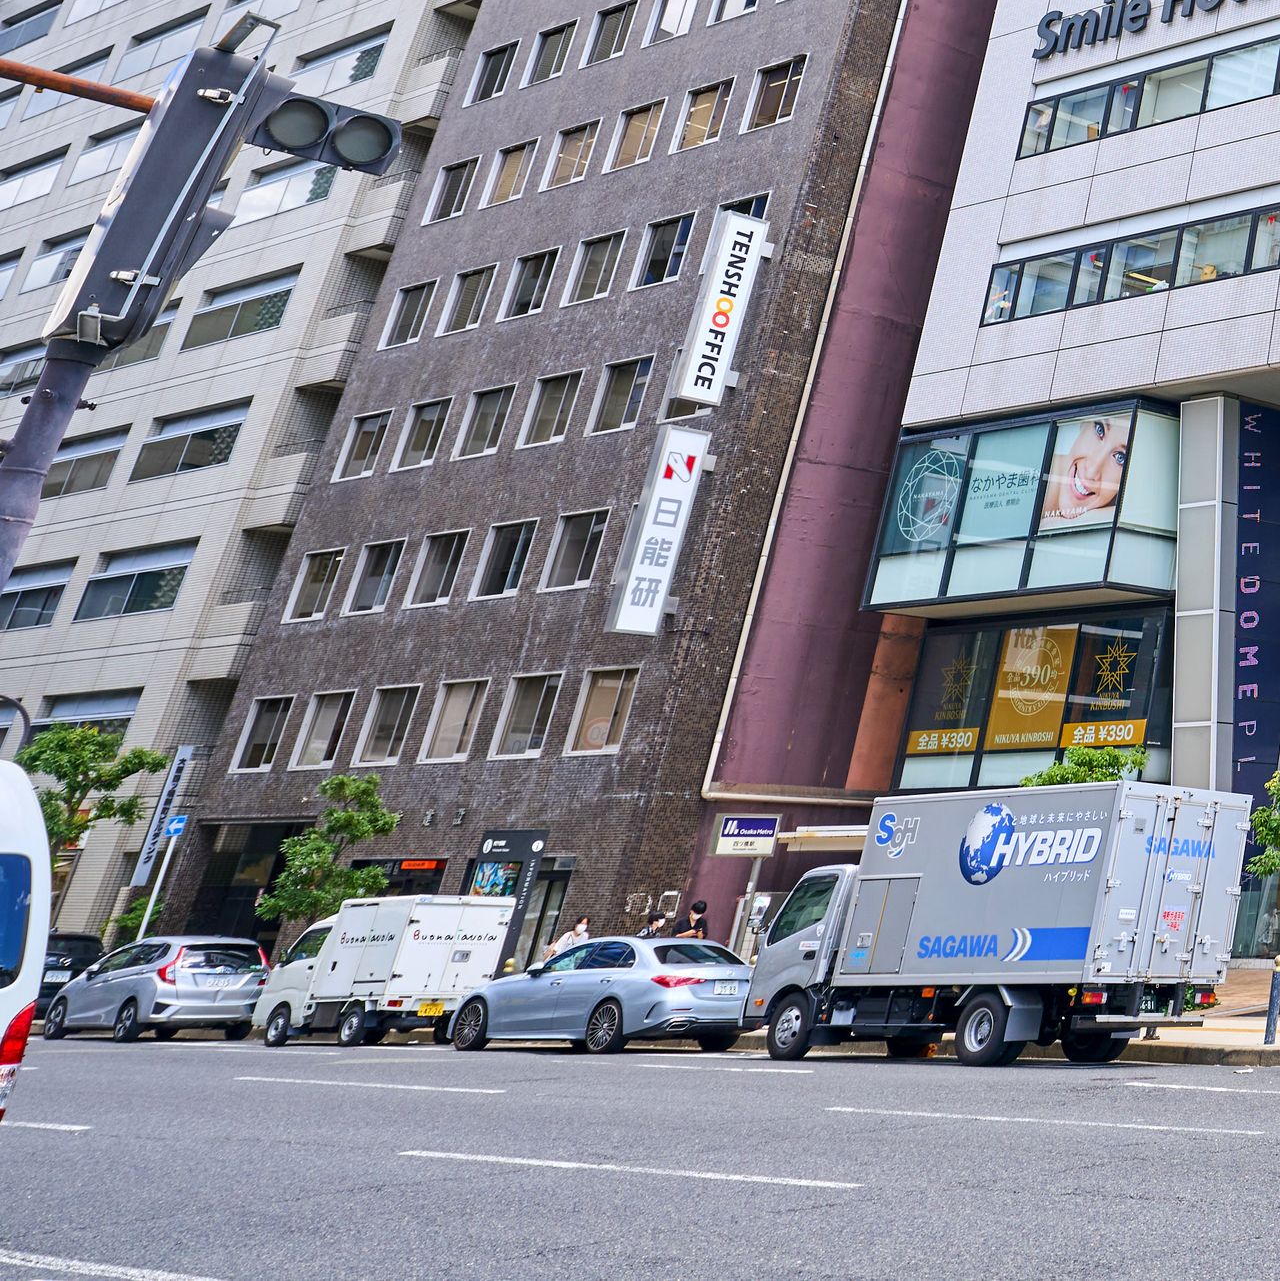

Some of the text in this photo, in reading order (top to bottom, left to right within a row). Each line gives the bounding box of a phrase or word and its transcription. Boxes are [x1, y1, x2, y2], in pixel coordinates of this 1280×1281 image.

[630, 497, 683, 609] 日能研
[1020, 665, 1051, 687] 390
[1090, 700, 1125, 711] KINBOSHI
[917, 732, 973, 750] 全品 ¥390
[994, 732, 1054, 744] NIKUYA KINBOSHI
[1072, 724, 1134, 743] 全品 ¥390
[990, 827, 1103, 868] HYBRID
[1145, 836, 1216, 858] SAGAWA
[518, 859, 536, 910] INFORMATION
[1043, 869, 1092, 882] ハイブリッド
[917, 934, 999, 959] SAGAWA
